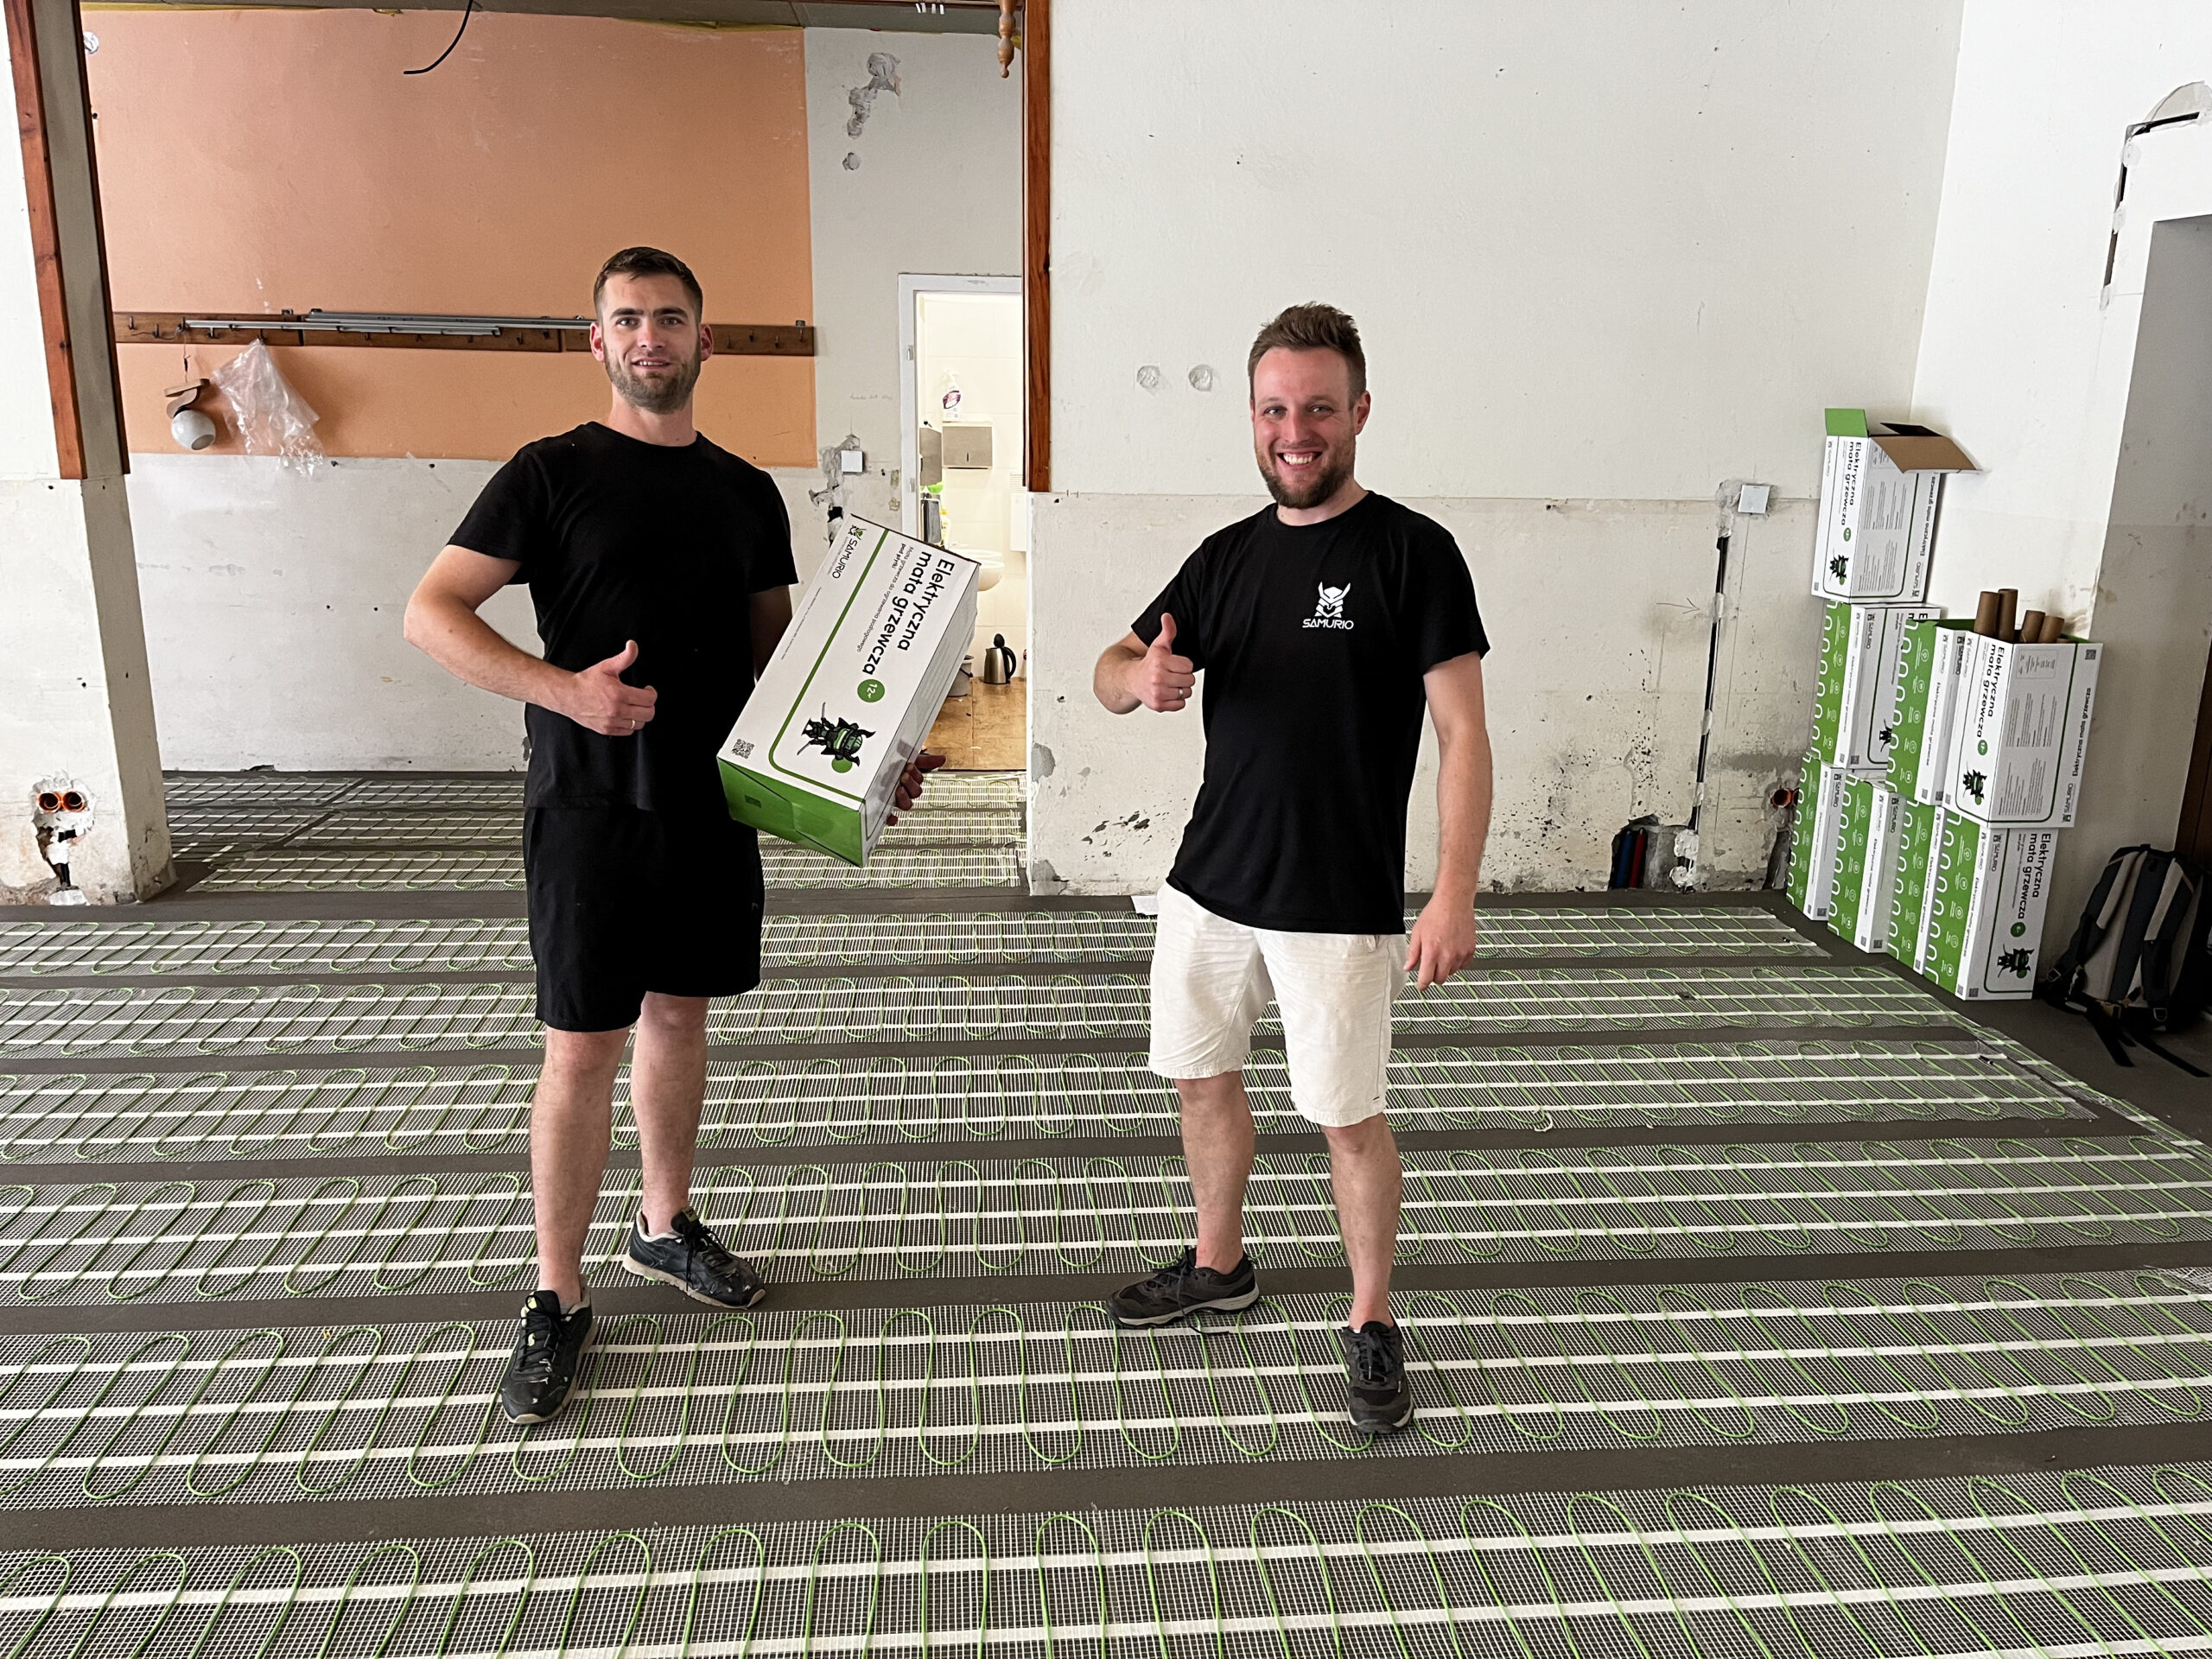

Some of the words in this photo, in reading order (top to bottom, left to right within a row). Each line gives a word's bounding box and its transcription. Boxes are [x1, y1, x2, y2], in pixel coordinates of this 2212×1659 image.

[1840, 474, 1851, 525] grzewcza
[1849, 442, 1862, 505] Elektryczna
[832, 538, 857, 579] SAMURIO
[903, 551, 932, 594] mata
[897, 558, 955, 651] Elektryczna
[1302, 618, 1354, 630] SAMURIO
[862, 596, 909, 675] grzewcza
[1986, 644, 1996, 677] mata
[1977, 680, 1990, 738] grzewcza
[1988, 646, 2005, 718] Elektryczna
[2072, 740, 2083, 777] Elektryczna
[2082, 688, 2091, 719] grzewcza
[2027, 833, 2037, 863] mata
[2032, 833, 2051, 898] Elektryczna
[2018, 866, 2032, 919] grzewcza
